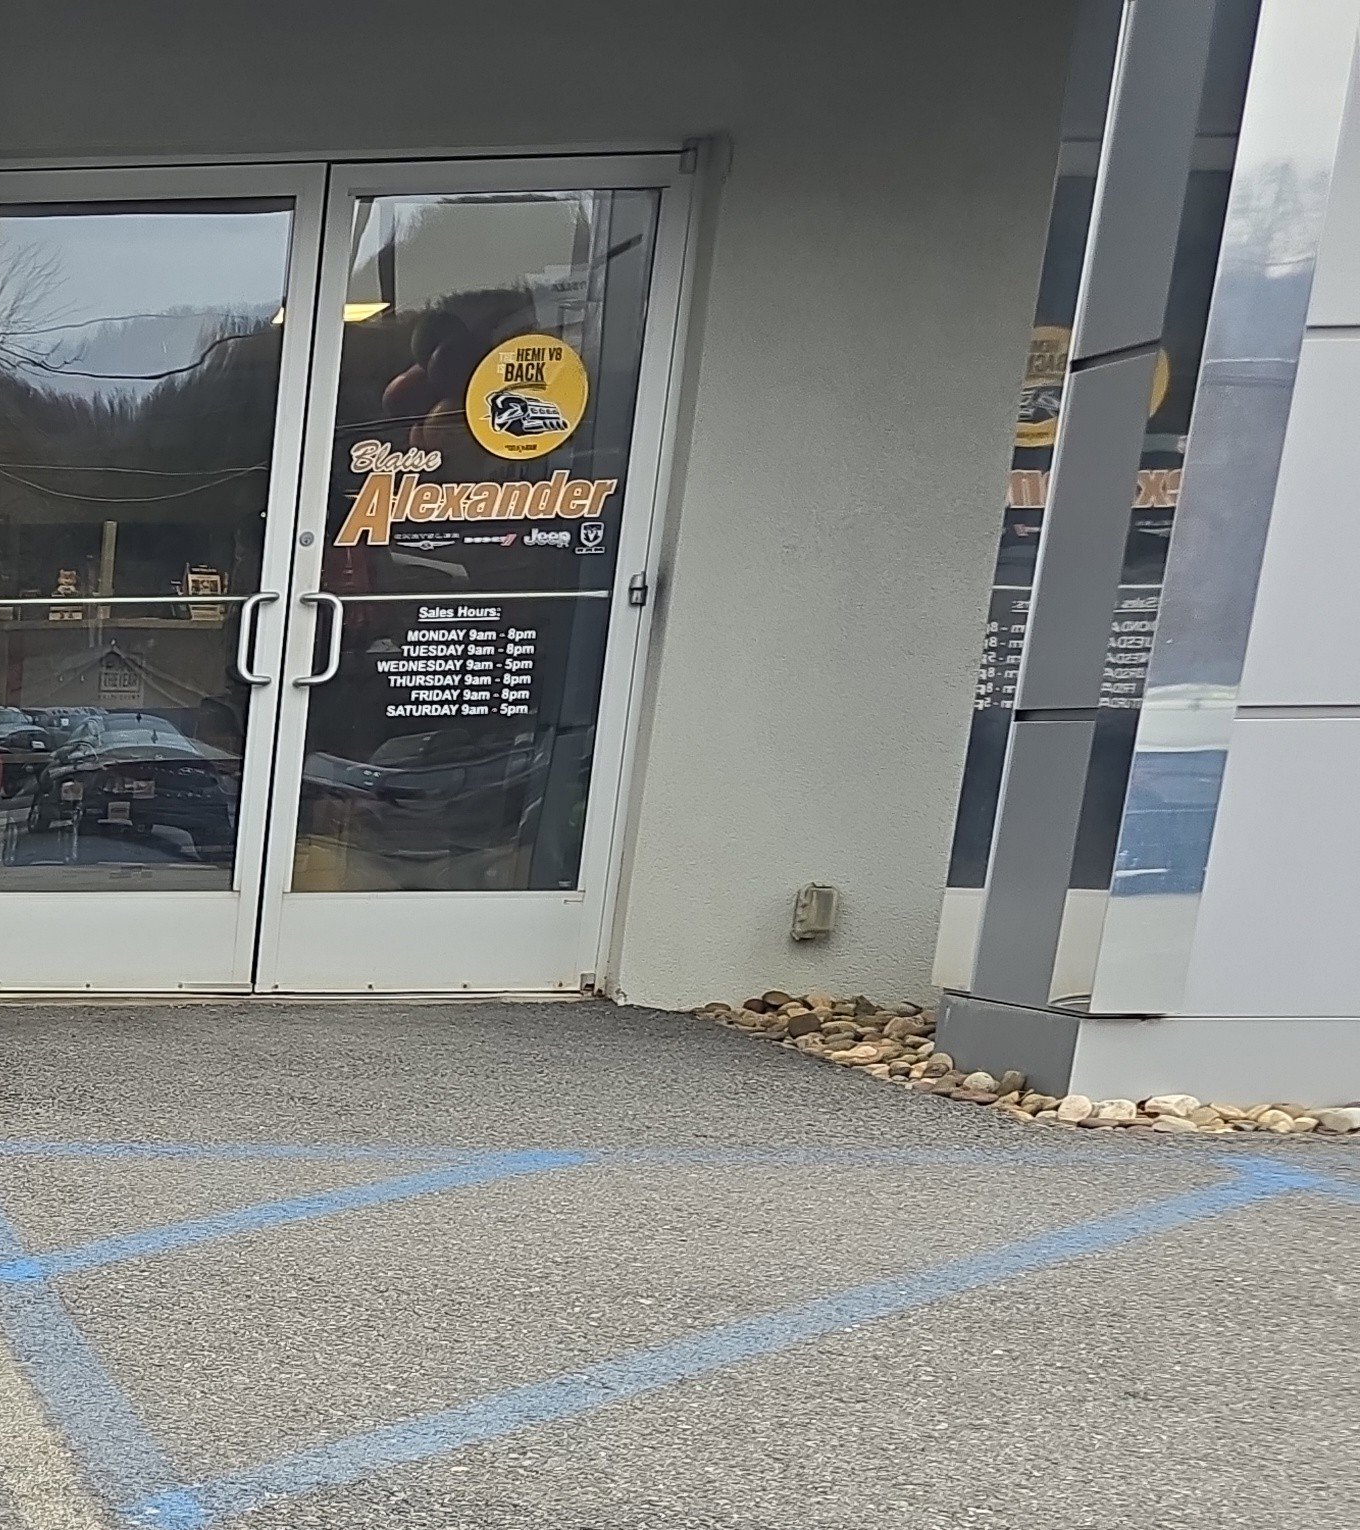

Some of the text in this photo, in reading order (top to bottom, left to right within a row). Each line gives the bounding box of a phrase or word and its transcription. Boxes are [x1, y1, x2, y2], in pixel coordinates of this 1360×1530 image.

[516, 347, 546, 362] HEMI
[548, 346, 563, 361] V8
[504, 362, 546, 382] BACK
[350, 439, 443, 473] Blaise
[333, 469, 618, 546] Alexander
[523, 527, 571, 548] Jeep
[418, 606, 502, 619] Sales Hours:
[406, 629, 467, 642] MONDAY
[468, 629, 497, 641] 9am
[507, 628, 537, 642] 8pm
[401, 644, 465, 657] TUESDAY
[467, 644, 495, 656] 9am
[506, 643, 535, 657] 8pm
[377, 659, 464, 672] WEDNESDAY
[465, 659, 493, 671] 9am
[504, 658, 533, 672] 5pm
[388, 674, 462, 687] THURSDAY
[464, 674, 492, 686] 9am
[502, 673, 531, 687] 8pm
[410, 689, 460, 702] FRIDAY
[462, 689, 490, 701] 9am
[501, 688, 530, 701] 8pm
[386, 704, 460, 717] SATURDAY
[460, 704, 489, 715] 9am
[499, 703, 529, 716] 5pm
